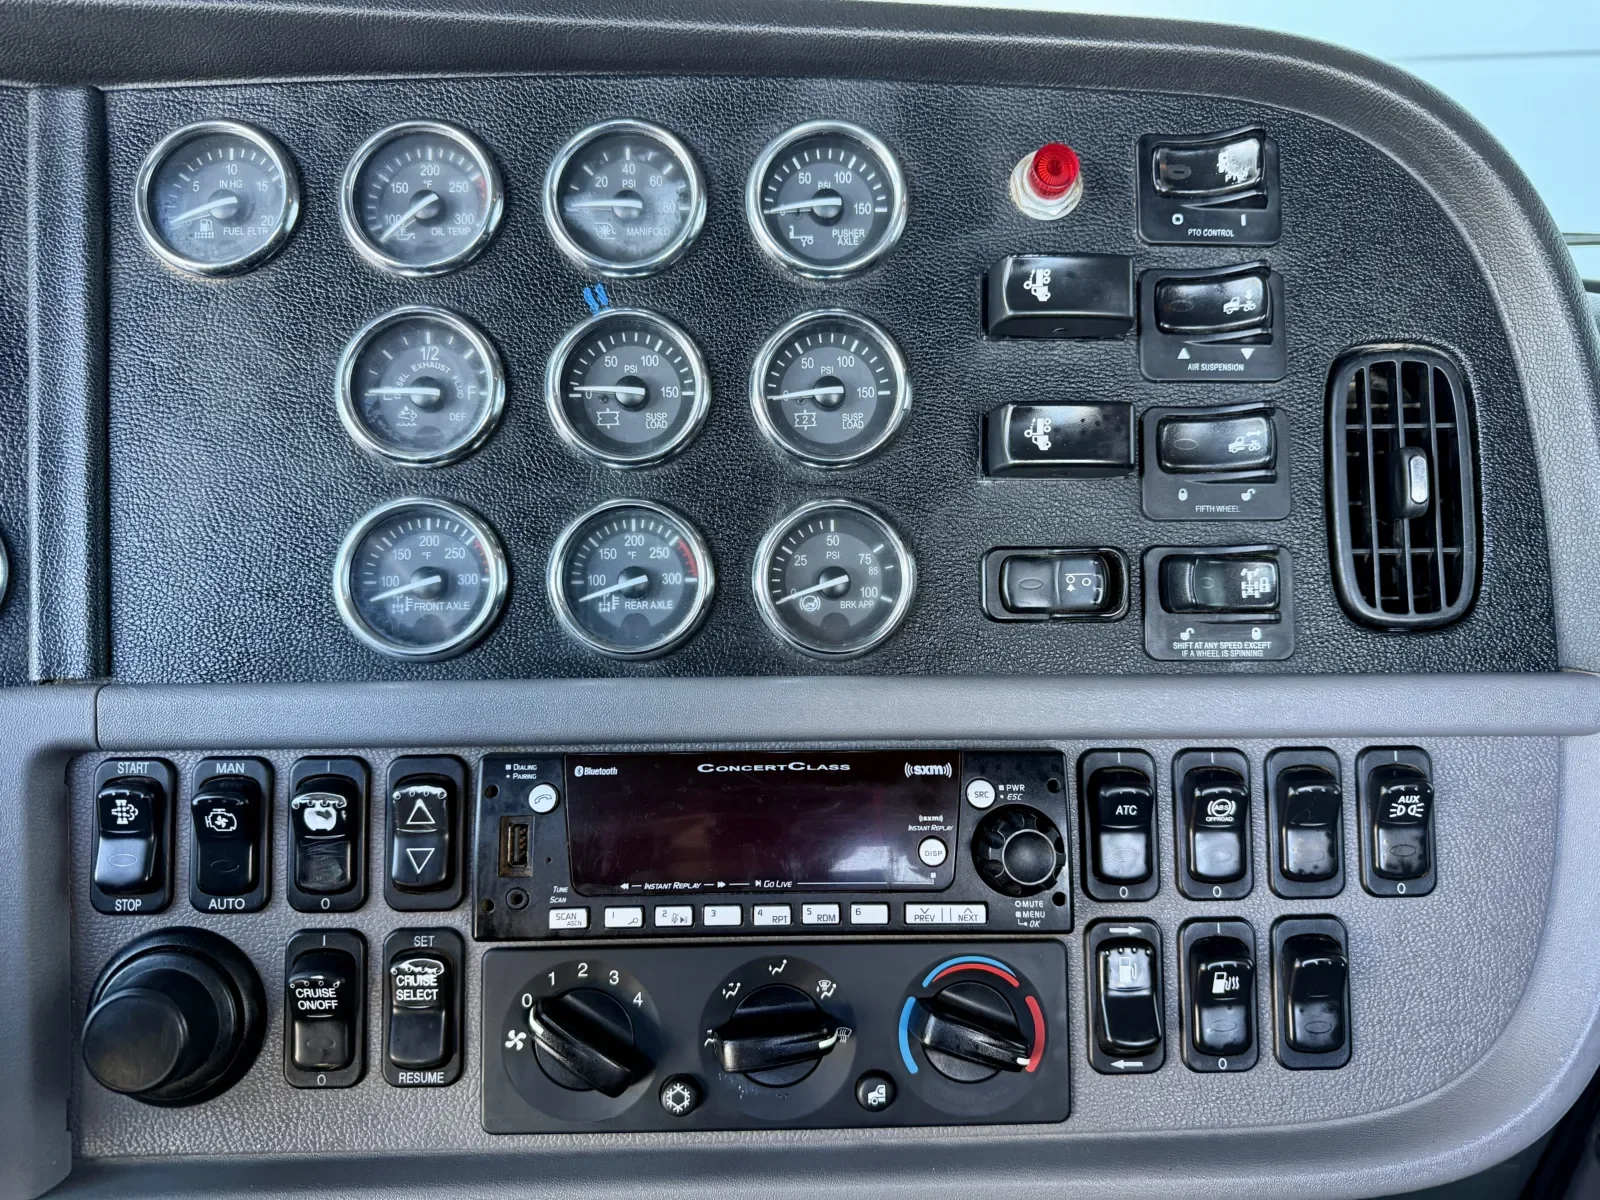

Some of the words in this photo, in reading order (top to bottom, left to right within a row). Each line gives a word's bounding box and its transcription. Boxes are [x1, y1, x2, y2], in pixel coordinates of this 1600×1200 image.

[225, 164, 238, 176] 10
[420, 165, 440, 176] 200
[622, 163, 636, 175] 40
[219, 179, 227, 188] IN
[229, 179, 243, 188] HG
[595, 176, 608, 188] 20
[622, 179, 636, 188] PSI
[650, 175, 663, 187] 60
[798, 173, 811, 185] 50
[834, 172, 852, 184] 100
[192, 181, 199, 193] 5
[257, 180, 268, 192] 15
[390, 182, 408, 193] 150
[449, 182, 469, 193] 250
[663, 202, 676, 213] 80
[854, 203, 872, 215] 150
[260, 215, 274, 226] 20
[454, 214, 474, 225] 300
[223, 227, 244, 236] FUEL
[247, 227, 269, 236] FLTR
[431, 228, 445, 236] OIL
[447, 227, 471, 236] TEMP
[627, 227, 670, 236] MANIFOLD
[832, 229, 865, 239] PUSHER
[1203, 229, 1235, 237] CONTROL
[837, 236, 859, 246] AXLE
[420, 345, 440, 361] 1/2
[604, 356, 618, 367] 50
[641, 356, 659, 367] 100
[801, 358, 814, 369] 50
[837, 357, 855, 368] 100
[1188, 363, 1199, 371] AIR
[1201, 363, 1244, 371] SUSPENSION
[410, 362, 452, 374] EXHAUST
[624, 365, 637, 374] PSI
[820, 366, 833, 375] PSI
[468, 386, 476, 400] F
[661, 387, 679, 398] 150
[857, 387, 875, 398] 150
[449, 412, 467, 421] DEF
[645, 413, 667, 422] SUSP
[842, 413, 863, 422] SUSP
[645, 421, 667, 429] LOAD
[842, 421, 864, 429] LOAD
[1196, 505, 1215, 513] FIFTH
[1216, 505, 1240, 513] WHEEL
[419, 535, 439, 547] 200
[624, 535, 644, 547] 200
[826, 535, 839, 546] 50
[393, 549, 411, 560] 150
[444, 548, 465, 559] 250
[599, 549, 617, 560] 150
[649, 547, 669, 559] 250
[826, 551, 839, 559] PSI
[794, 555, 807, 566] 25
[859, 554, 872, 565] 75
[868, 567, 878, 575] 85
[381, 576, 399, 587] 100
[457, 574, 478, 585] 300
[588, 575, 606, 586] 100
[661, 574, 682, 585] 300
[860, 587, 877, 598] 100
[414, 602, 444, 611] FRONT
[446, 601, 470, 610] AXLE
[625, 601, 649, 610] REAR
[650, 600, 673, 609] AXLE
[840, 601, 856, 609] BRK
[858, 601, 874, 609] APP
[117, 762, 149, 774] START
[216, 763, 244, 773] MAN
[584, 767, 618, 776] Bluetooth
[1398, 795, 1420, 803] AUX
[1115, 805, 1137, 816] ATC
[673, 881, 701, 889] REPLAY
[115, 899, 142, 911] STOP
[208, 898, 245, 910] AUTO
[757, 909, 763, 917] 4
[855, 908, 861, 916] 6
[817, 914, 836, 922] RDM
[958, 914, 978, 922] NEXT
[414, 936, 435, 947] SET
[578, 963, 588, 977] 2
[396, 975, 437, 986] CRUISE
[548, 971, 555, 985] 1
[609, 971, 619, 985] 3
[295, 988, 336, 998] CRUISE
[396, 989, 439, 1001] SELECT
[298, 1000, 338, 1010] ON/OFF
[633, 992, 643, 1007] 4
[399, 1072, 445, 1084] RESUME
